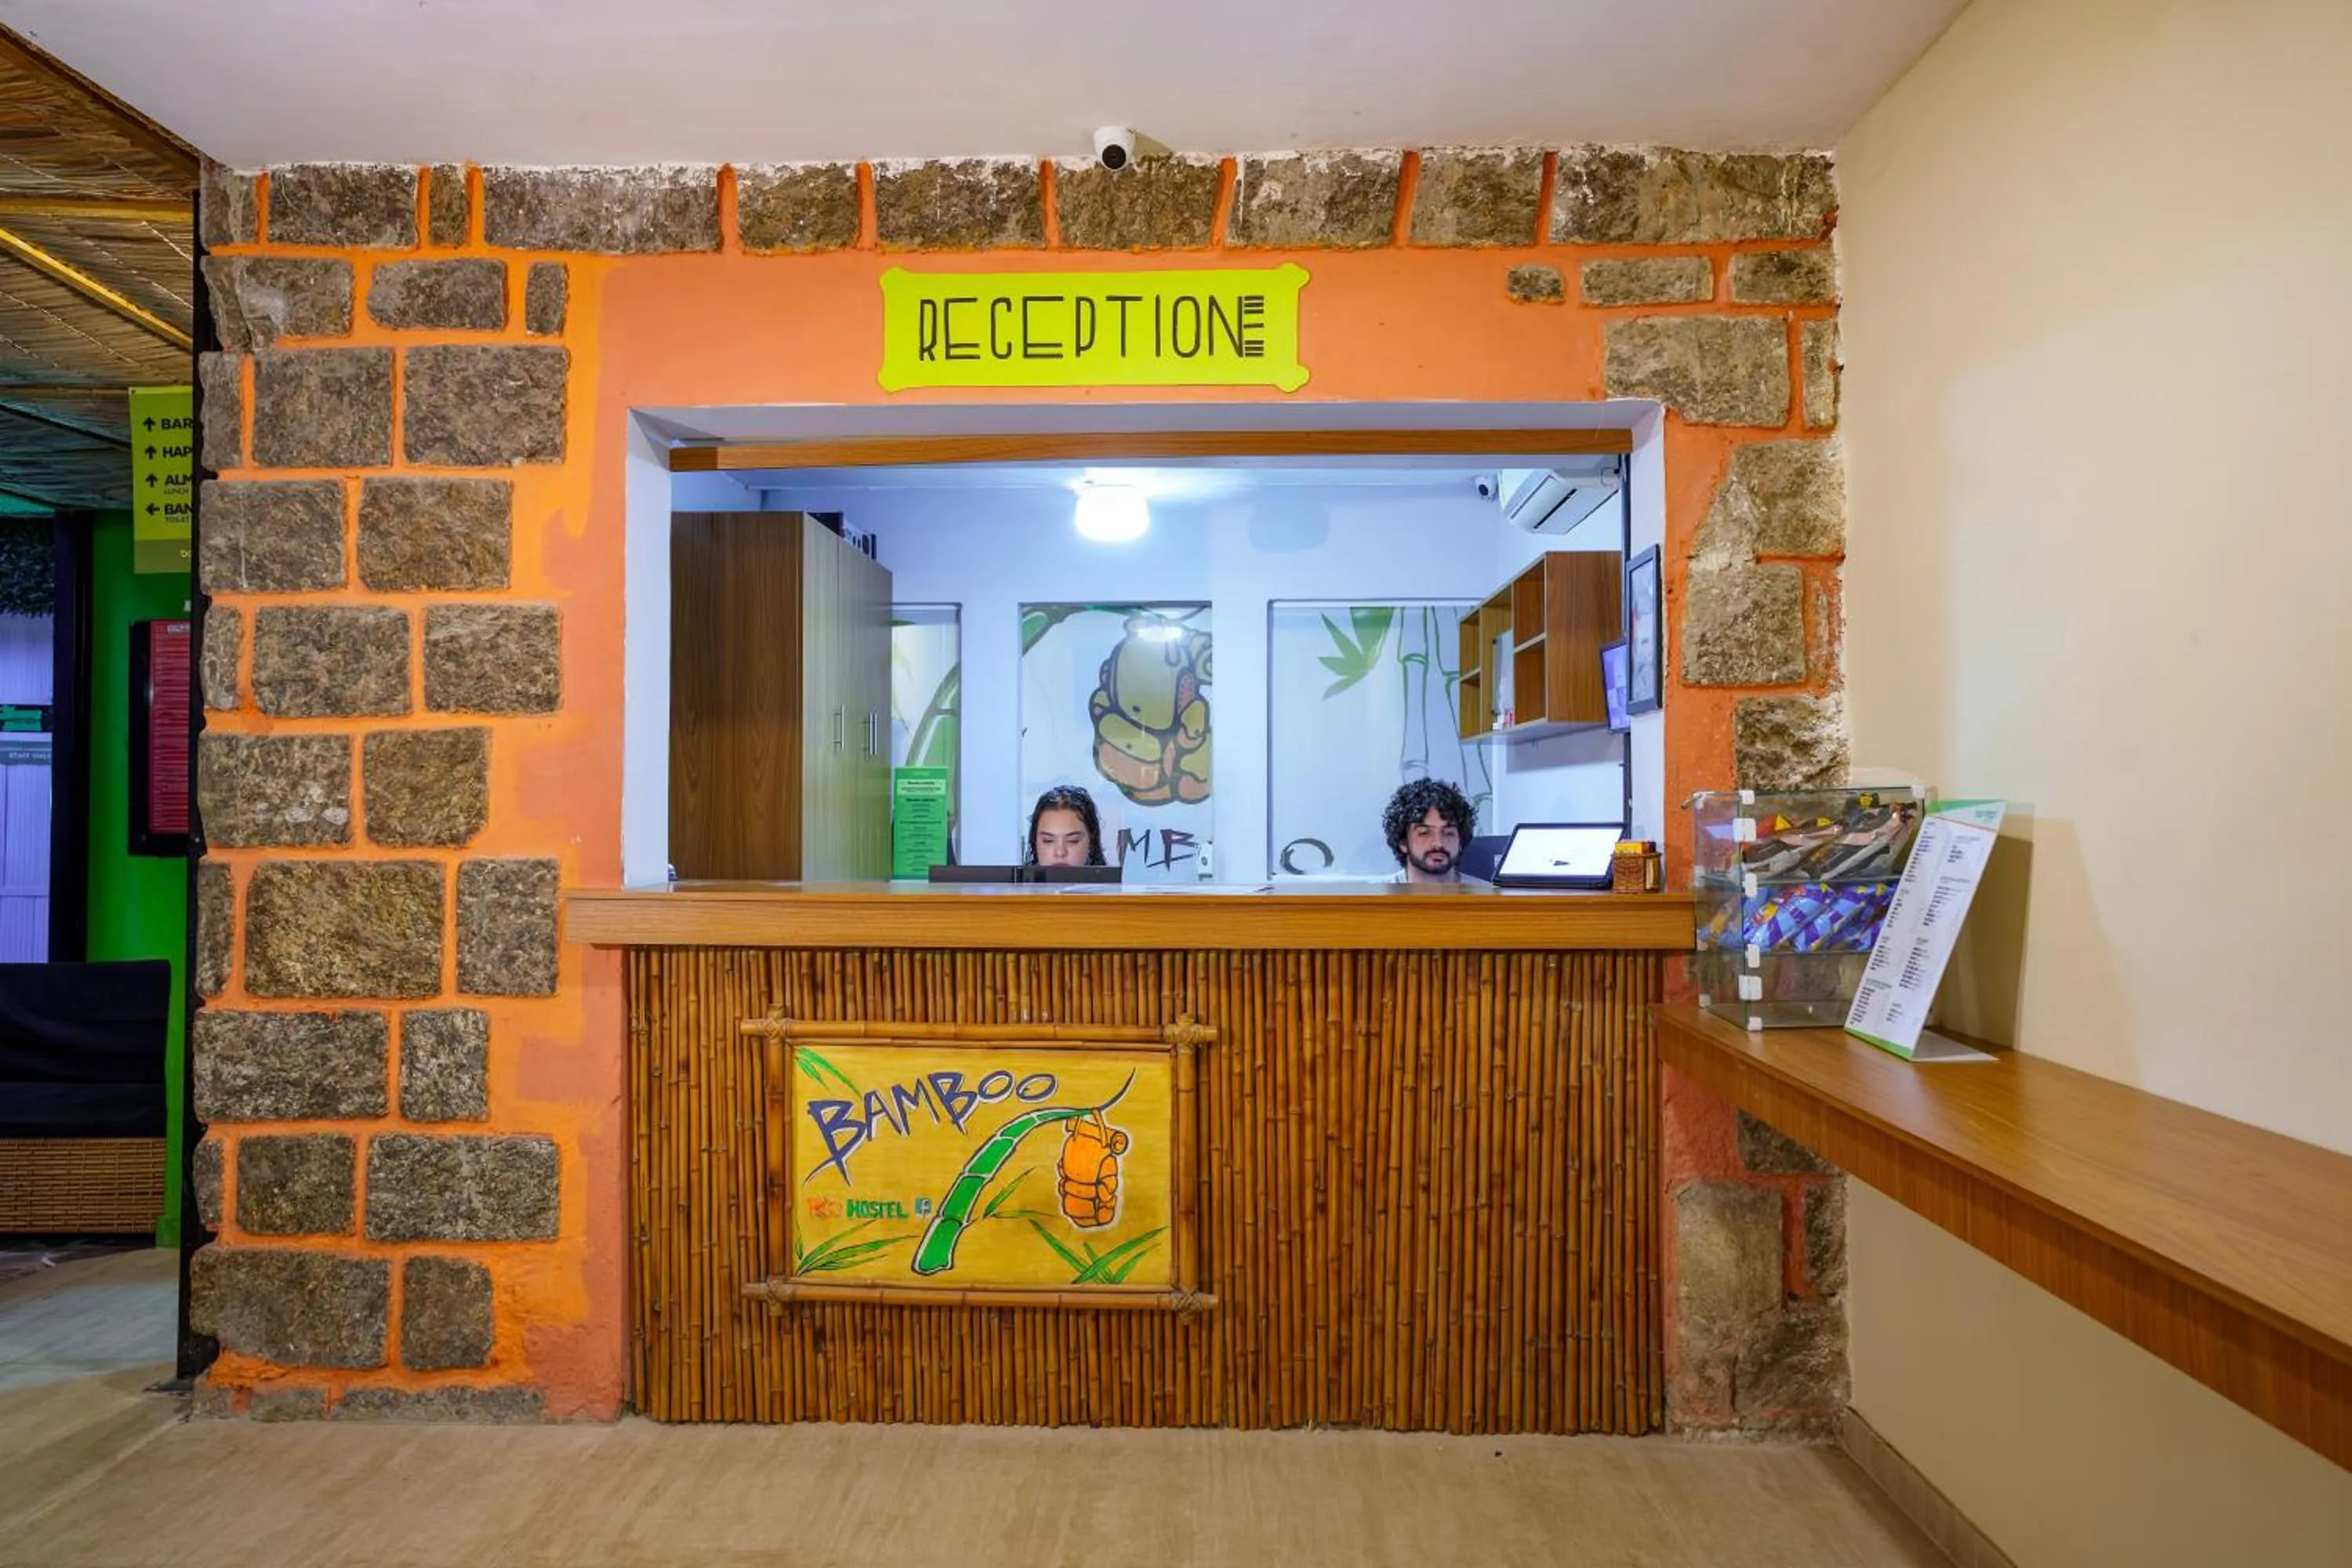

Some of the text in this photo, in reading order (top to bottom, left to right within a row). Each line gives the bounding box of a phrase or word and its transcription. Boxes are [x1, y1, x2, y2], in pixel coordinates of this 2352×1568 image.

[919, 293, 1265, 361] RECEPTION
[804, 1070, 1057, 1186] BAMBOO
[846, 1199, 909, 1219] HOSTEL
